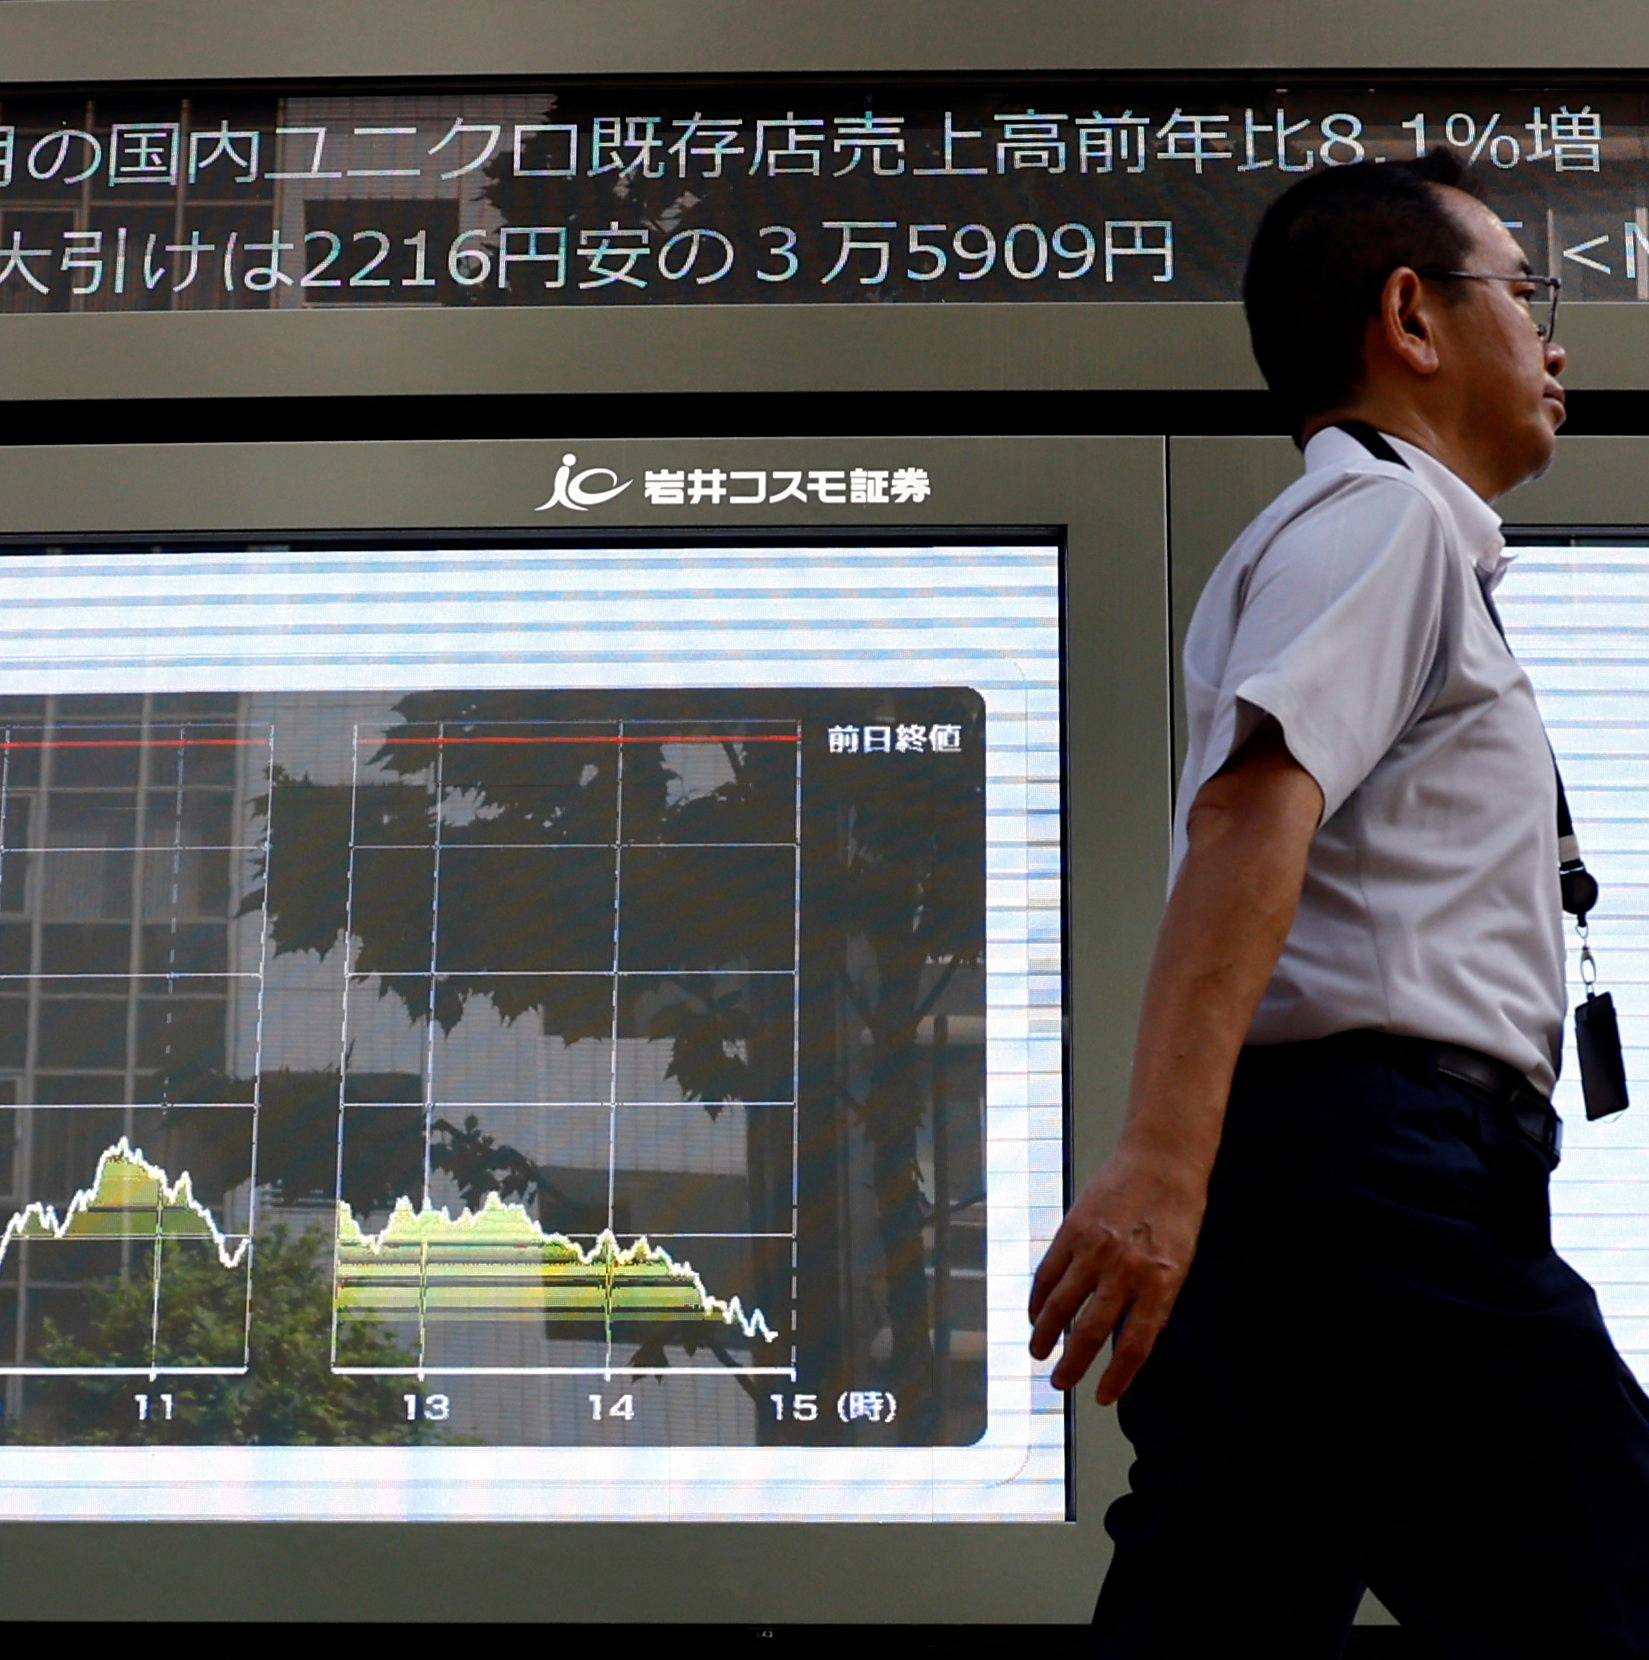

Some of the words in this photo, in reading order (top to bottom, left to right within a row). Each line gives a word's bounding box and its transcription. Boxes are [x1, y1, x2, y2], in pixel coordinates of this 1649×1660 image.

[644, 467, 931, 505] 岩井コスモ証券
[827, 723, 963, 755] 前日終値
[135, 1396, 174, 1420] 11
[403, 1396, 450, 1421] 13
[588, 1396, 635, 1421] 14
[770, 1396, 819, 1421] 15
